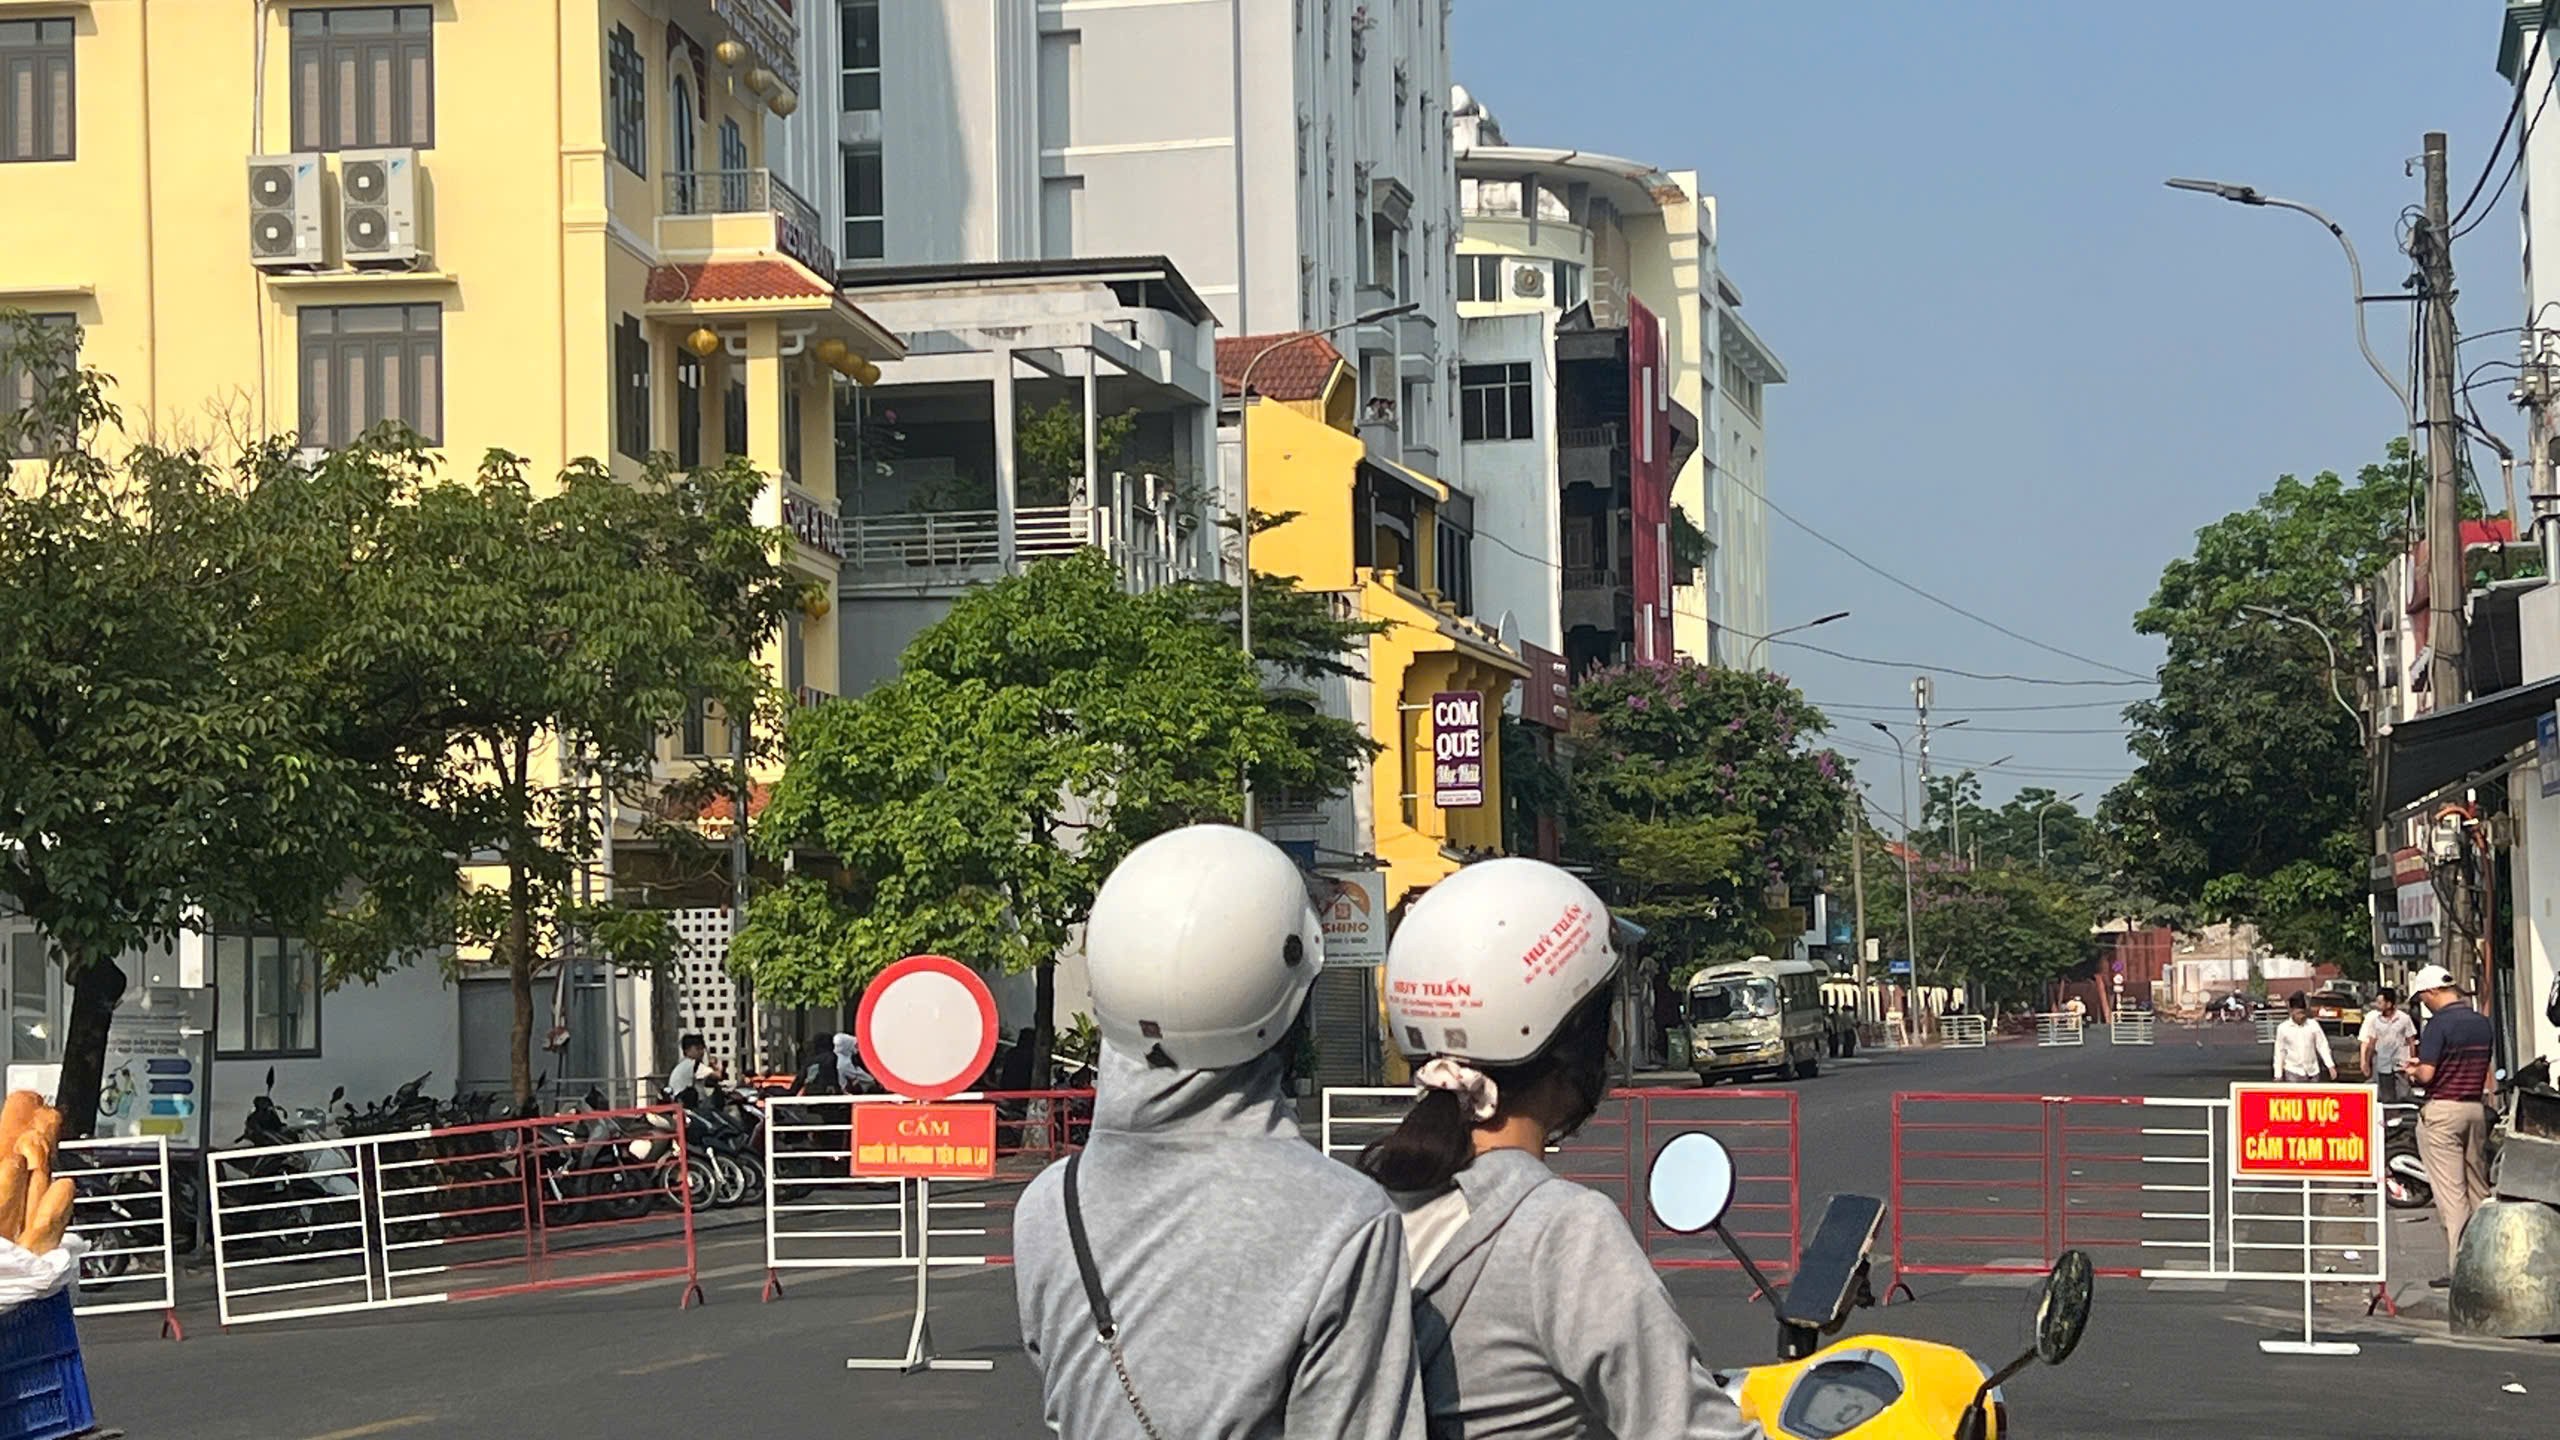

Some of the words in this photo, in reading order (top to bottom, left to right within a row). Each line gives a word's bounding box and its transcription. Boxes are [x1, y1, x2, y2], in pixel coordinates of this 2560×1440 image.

[1422, 976, 1471, 997] TUẤN
[898, 1113, 950, 1137] CẤM
[2268, 1098, 2303, 1123] KHU
[2305, 1096, 2341, 1128] VỰC
[2245, 1128, 2284, 1161] CẤM
[2287, 1136, 2323, 1167] TẠM
[2326, 1131, 2365, 1163] THỜI
